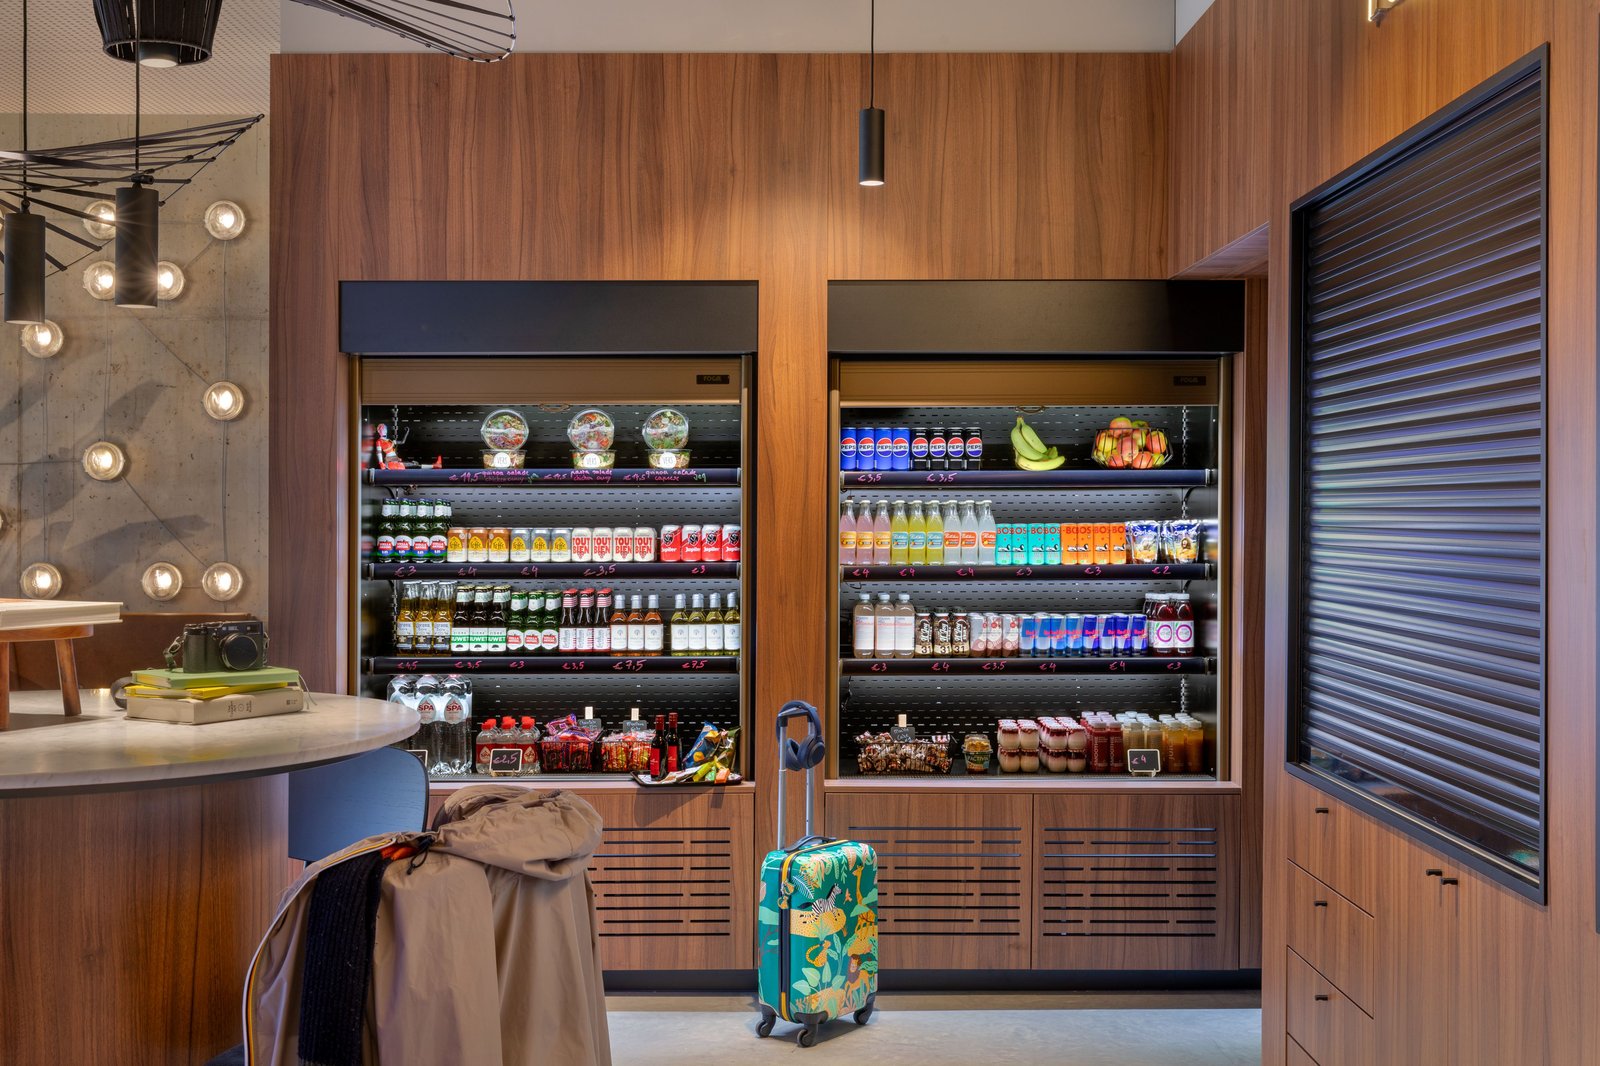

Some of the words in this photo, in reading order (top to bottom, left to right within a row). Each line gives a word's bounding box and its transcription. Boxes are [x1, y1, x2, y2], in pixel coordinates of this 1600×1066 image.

[1066, 526, 1078, 534] BO
[1078, 526, 1092, 534] OS
[1112, 526, 1125, 534] BO
[572, 537, 590, 545] TOUT
[593, 537, 611, 545] TOUT
[615, 537, 633, 545] TOUT
[635, 537, 652, 545] TOUT
[573, 546, 589, 554] BIEN
[594, 546, 611, 554] BIEN
[616, 546, 633, 554] BIEN
[635, 546, 652, 554] BIEN
